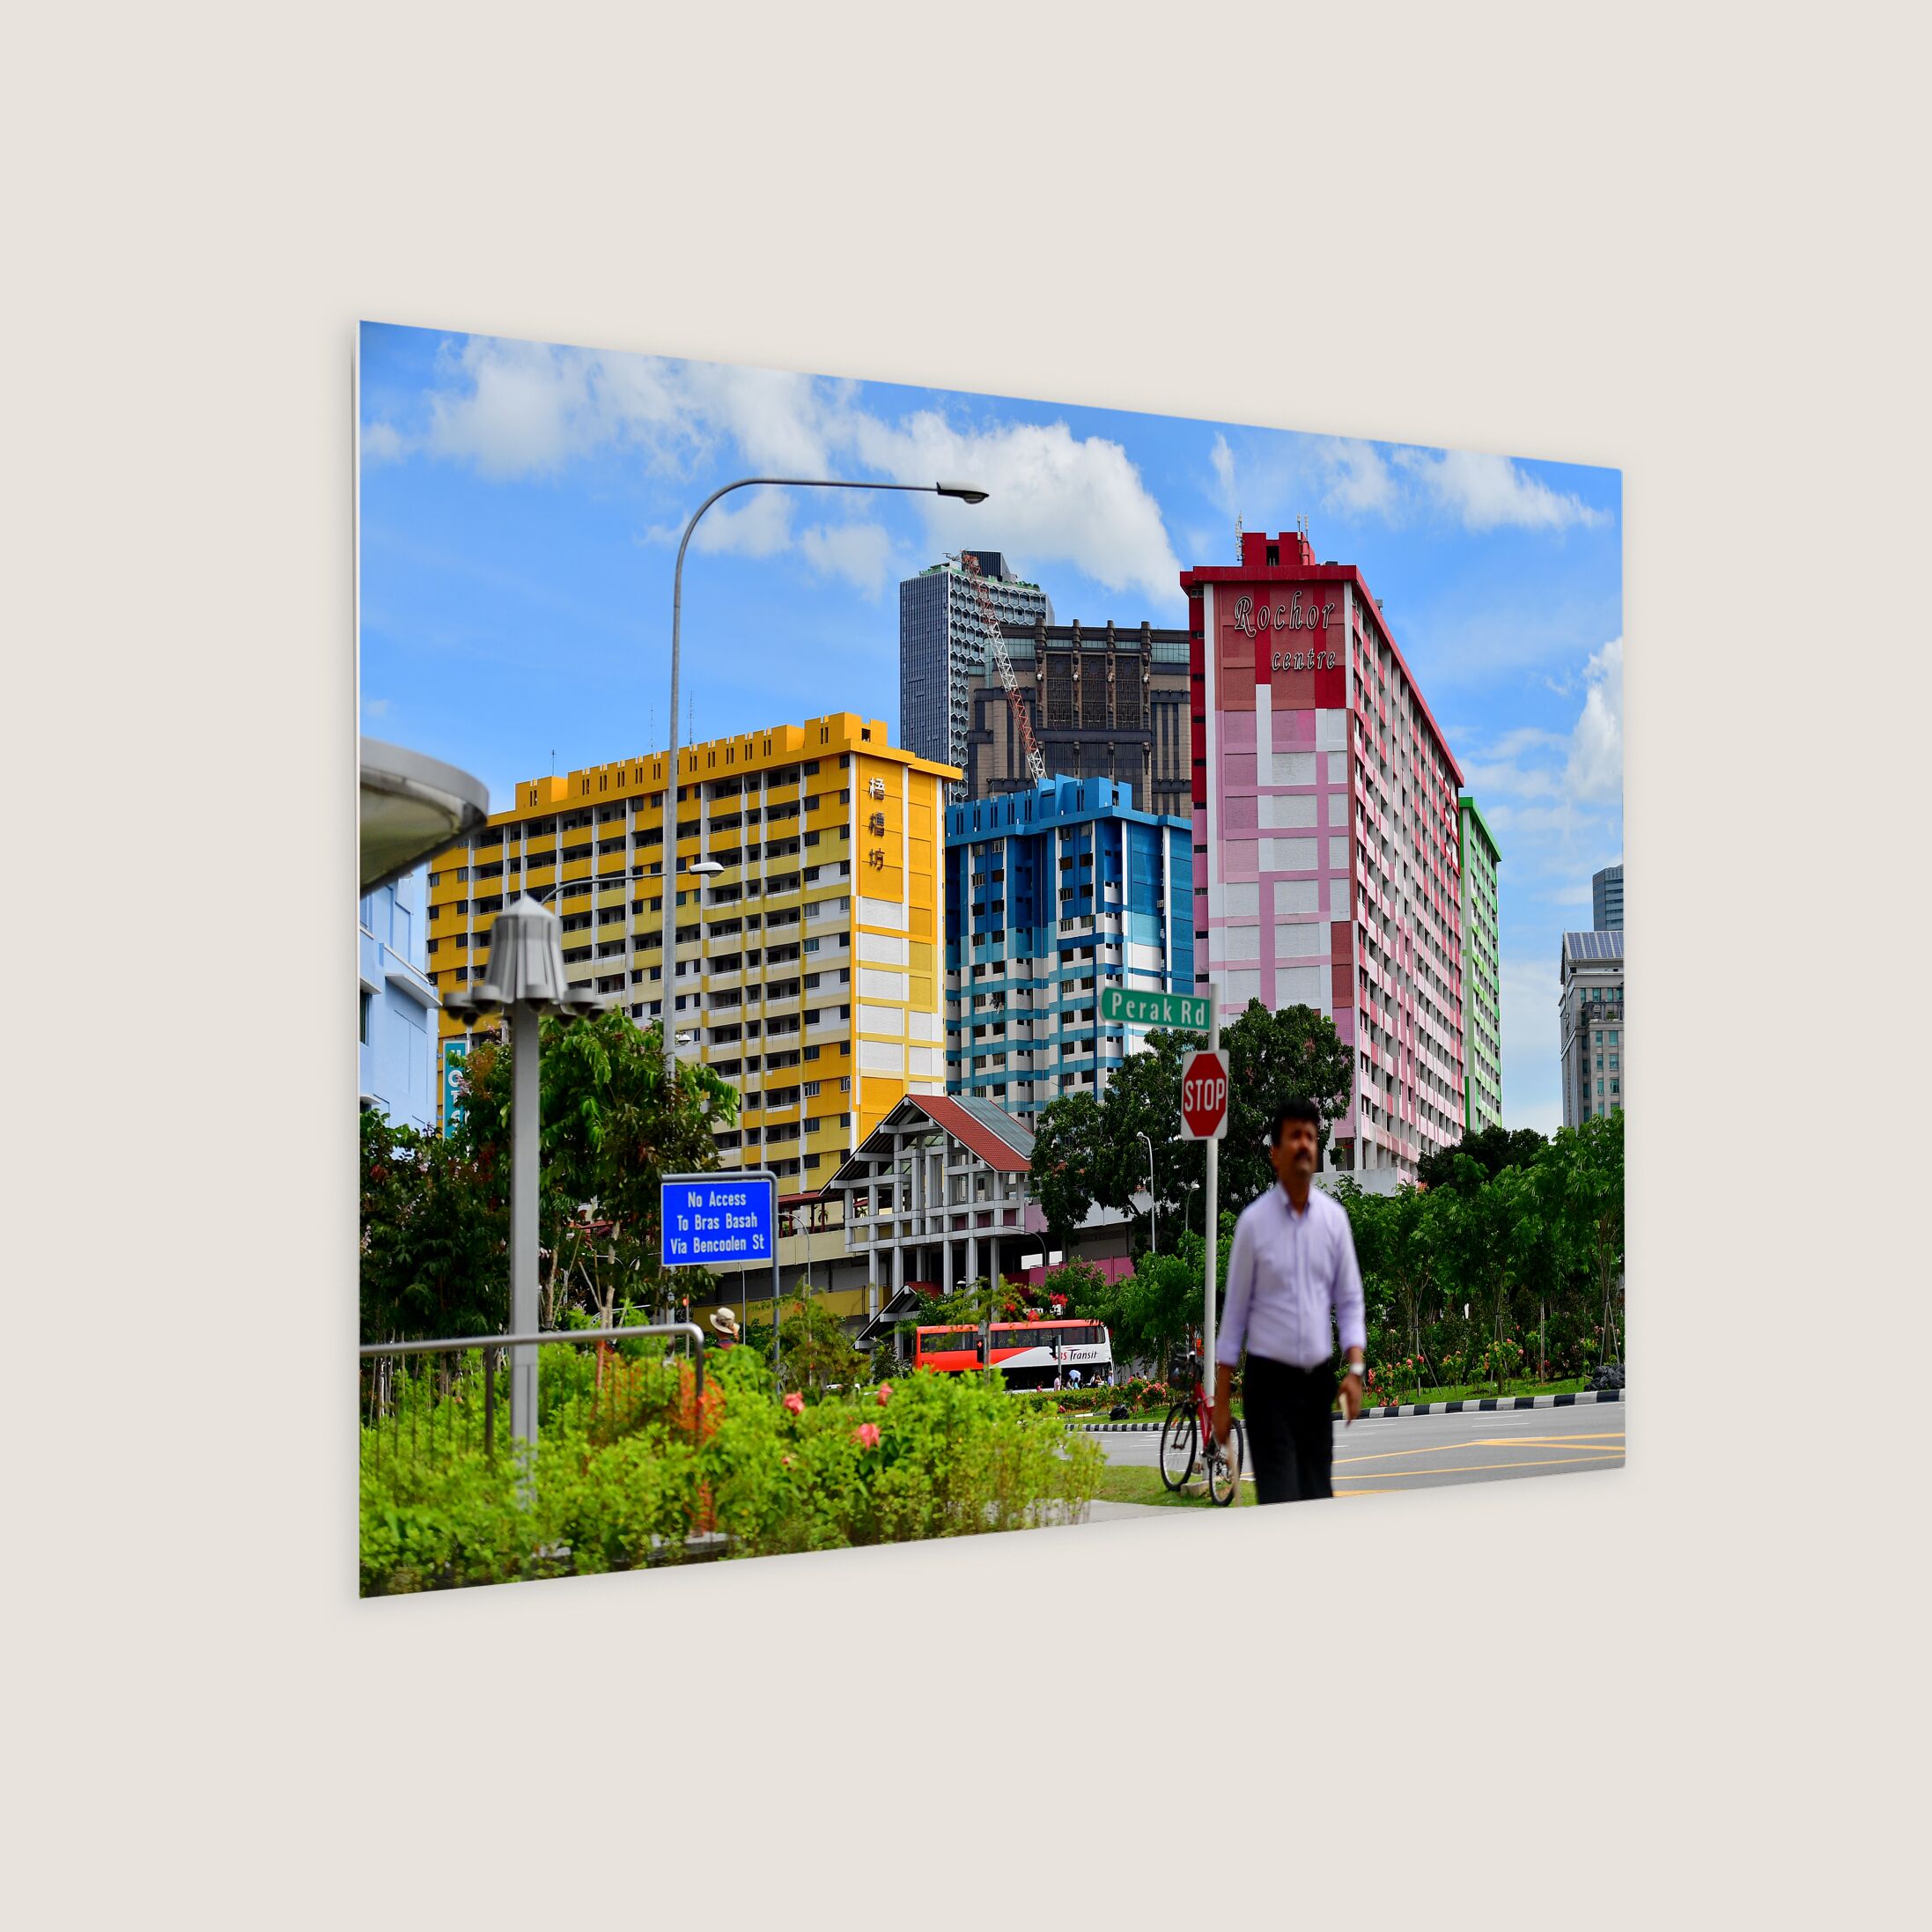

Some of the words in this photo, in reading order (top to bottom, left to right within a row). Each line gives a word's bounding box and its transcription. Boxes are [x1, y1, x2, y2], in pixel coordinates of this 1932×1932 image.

[1235, 591, 1335, 638] Rochor
[1272, 648, 1336, 671] centre
[1112, 992, 1172, 1022] Perak
[1181, 1000, 1205, 1026] Rd
[1184, 1078, 1226, 1112] STOP
[688, 1191, 703, 1208] No
[709, 1191, 747, 1207] Access
[677, 1214, 689, 1231] To
[695, 1214, 720, 1230] Bras
[726, 1212, 757, 1228] Basah
[670, 1238, 687, 1254] Via
[693, 1236, 747, 1253] Bencoolen
[752, 1234, 764, 1250] St
[1066, 1348, 1098, 1361] Transit
